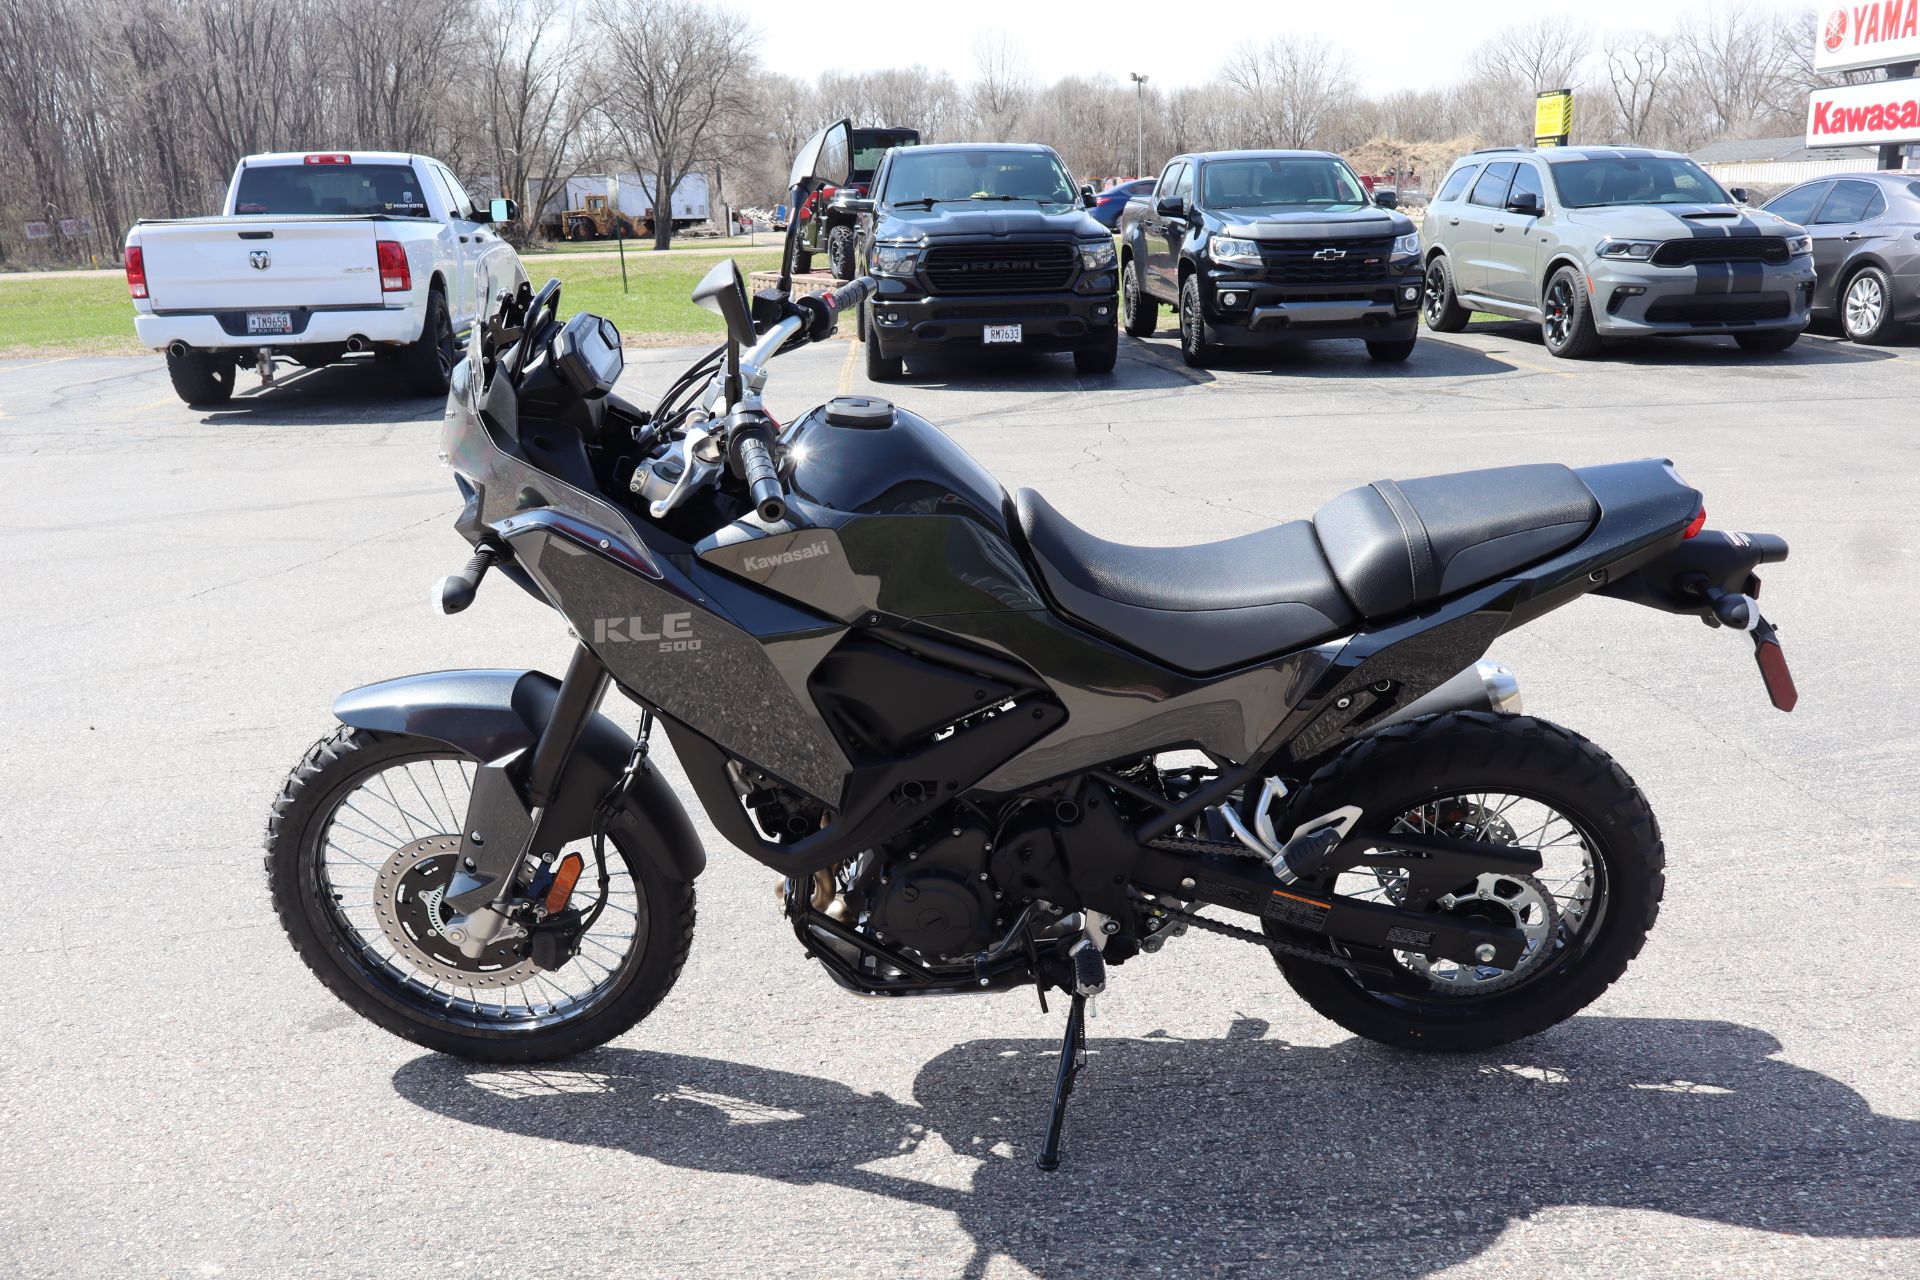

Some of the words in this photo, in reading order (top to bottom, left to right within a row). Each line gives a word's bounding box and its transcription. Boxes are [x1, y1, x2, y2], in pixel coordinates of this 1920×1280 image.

[1812, 99, 1920, 135] Kawasa
[990, 329, 1019, 339] RM7633
[743, 540, 830, 572] Kawasaki
[594, 612, 693, 643] KLE
[659, 639, 702, 653] 500
